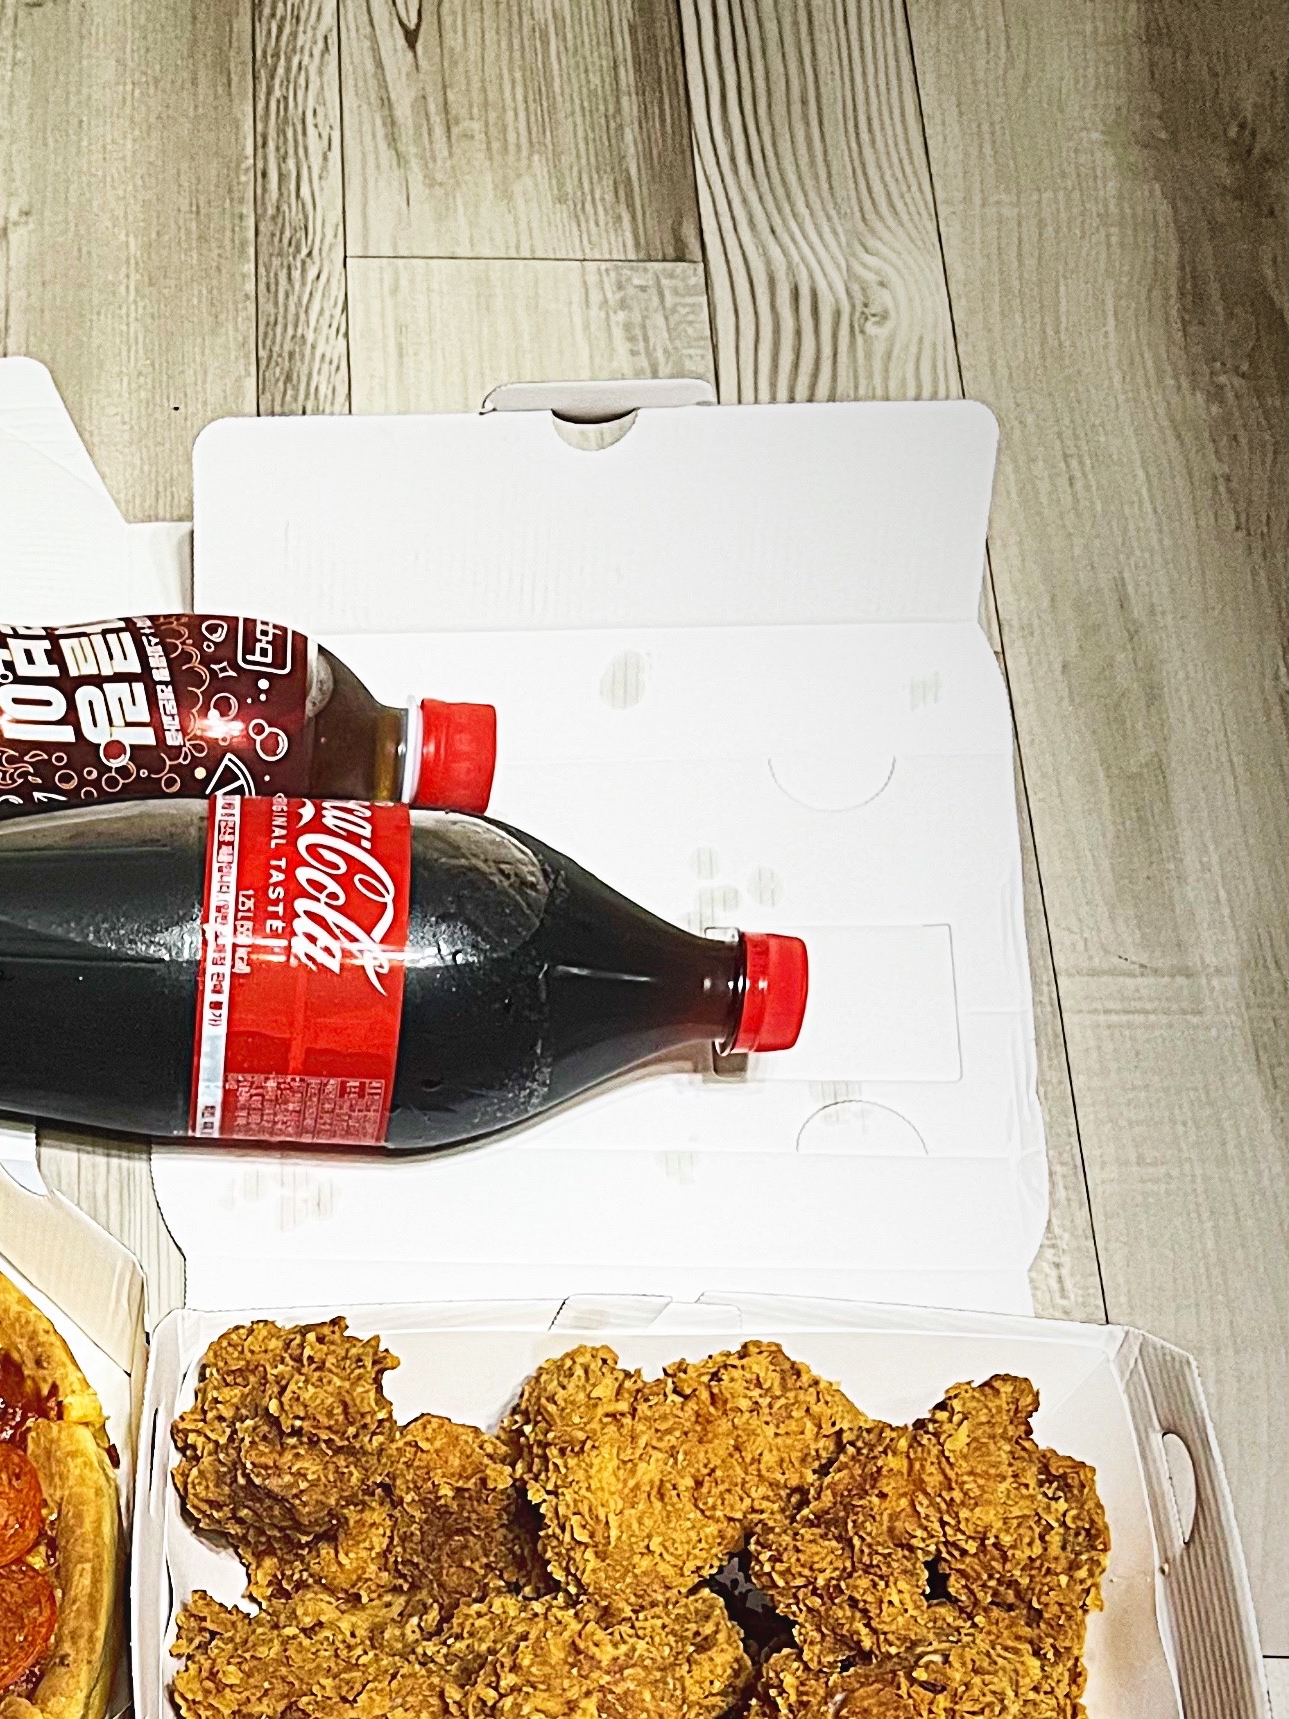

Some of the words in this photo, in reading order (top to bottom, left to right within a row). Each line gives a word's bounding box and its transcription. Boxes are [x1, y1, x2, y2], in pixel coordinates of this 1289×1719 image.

[271, 793, 287, 848] GINAL
[266, 857, 287, 933] TASTE
[291, 836, 398, 996] Cola
